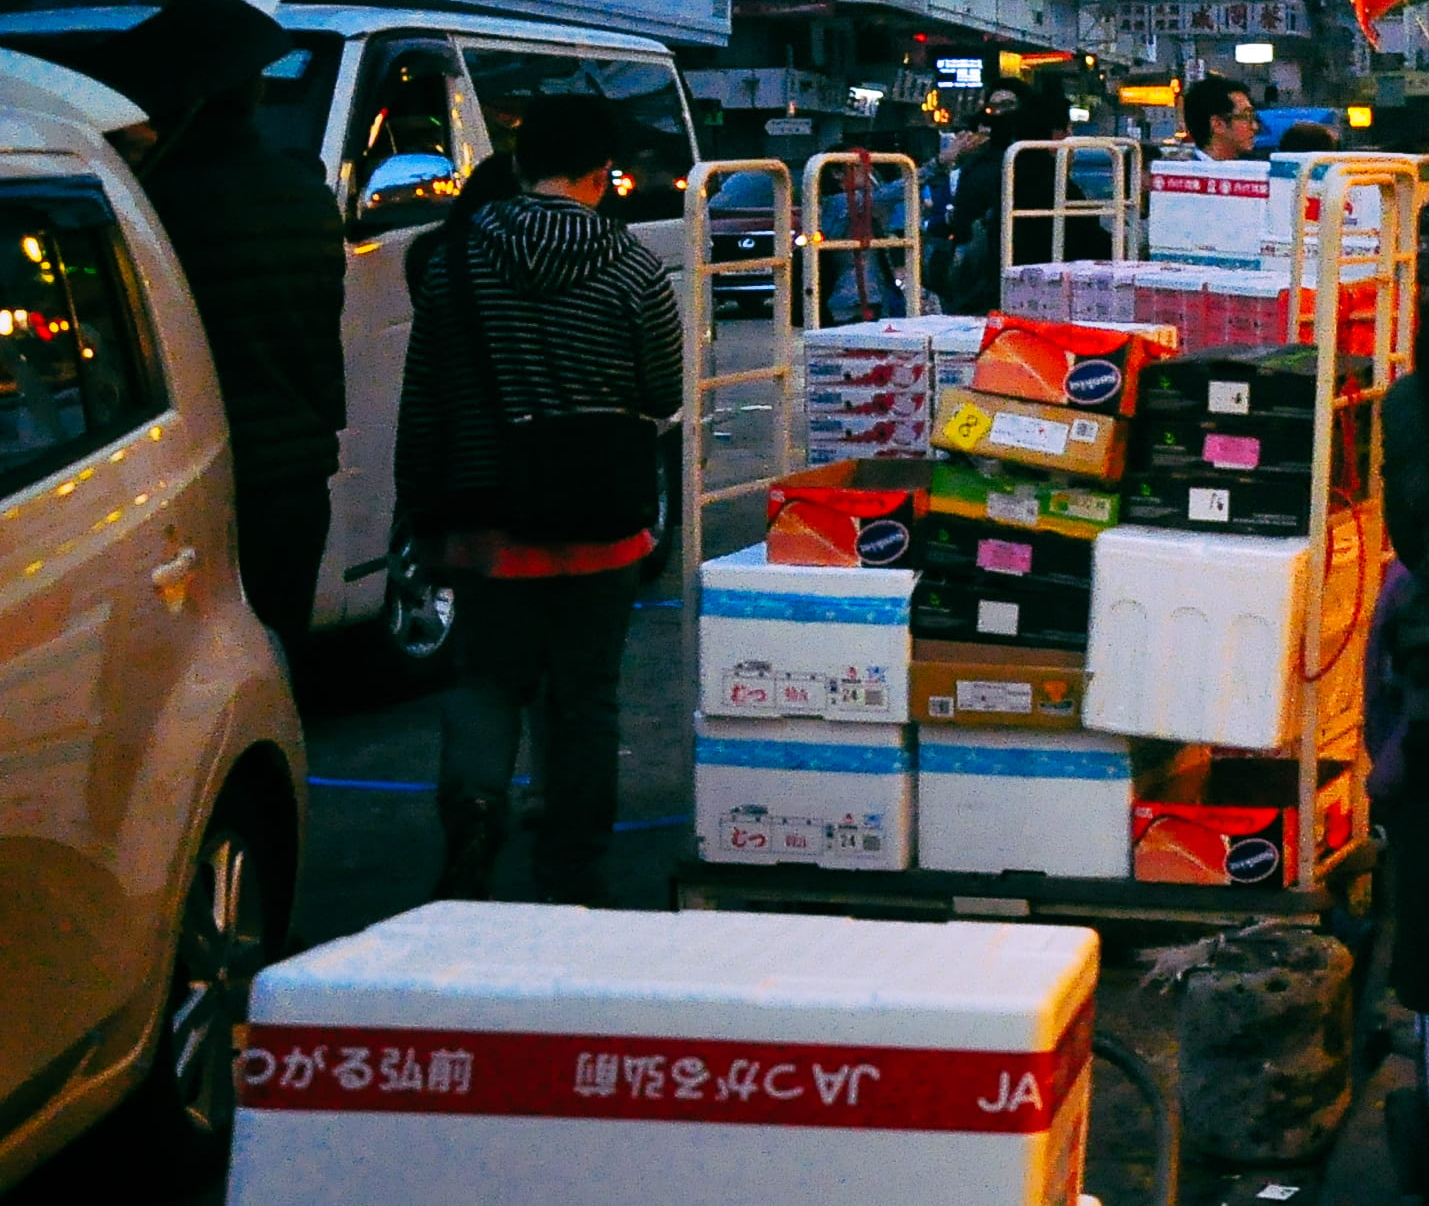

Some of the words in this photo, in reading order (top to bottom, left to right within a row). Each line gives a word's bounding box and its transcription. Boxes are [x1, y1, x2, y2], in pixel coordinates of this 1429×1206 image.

[731, 682, 769, 705] むつ
[731, 826, 767, 849] むつ
[977, 1070, 1045, 1113] JA
